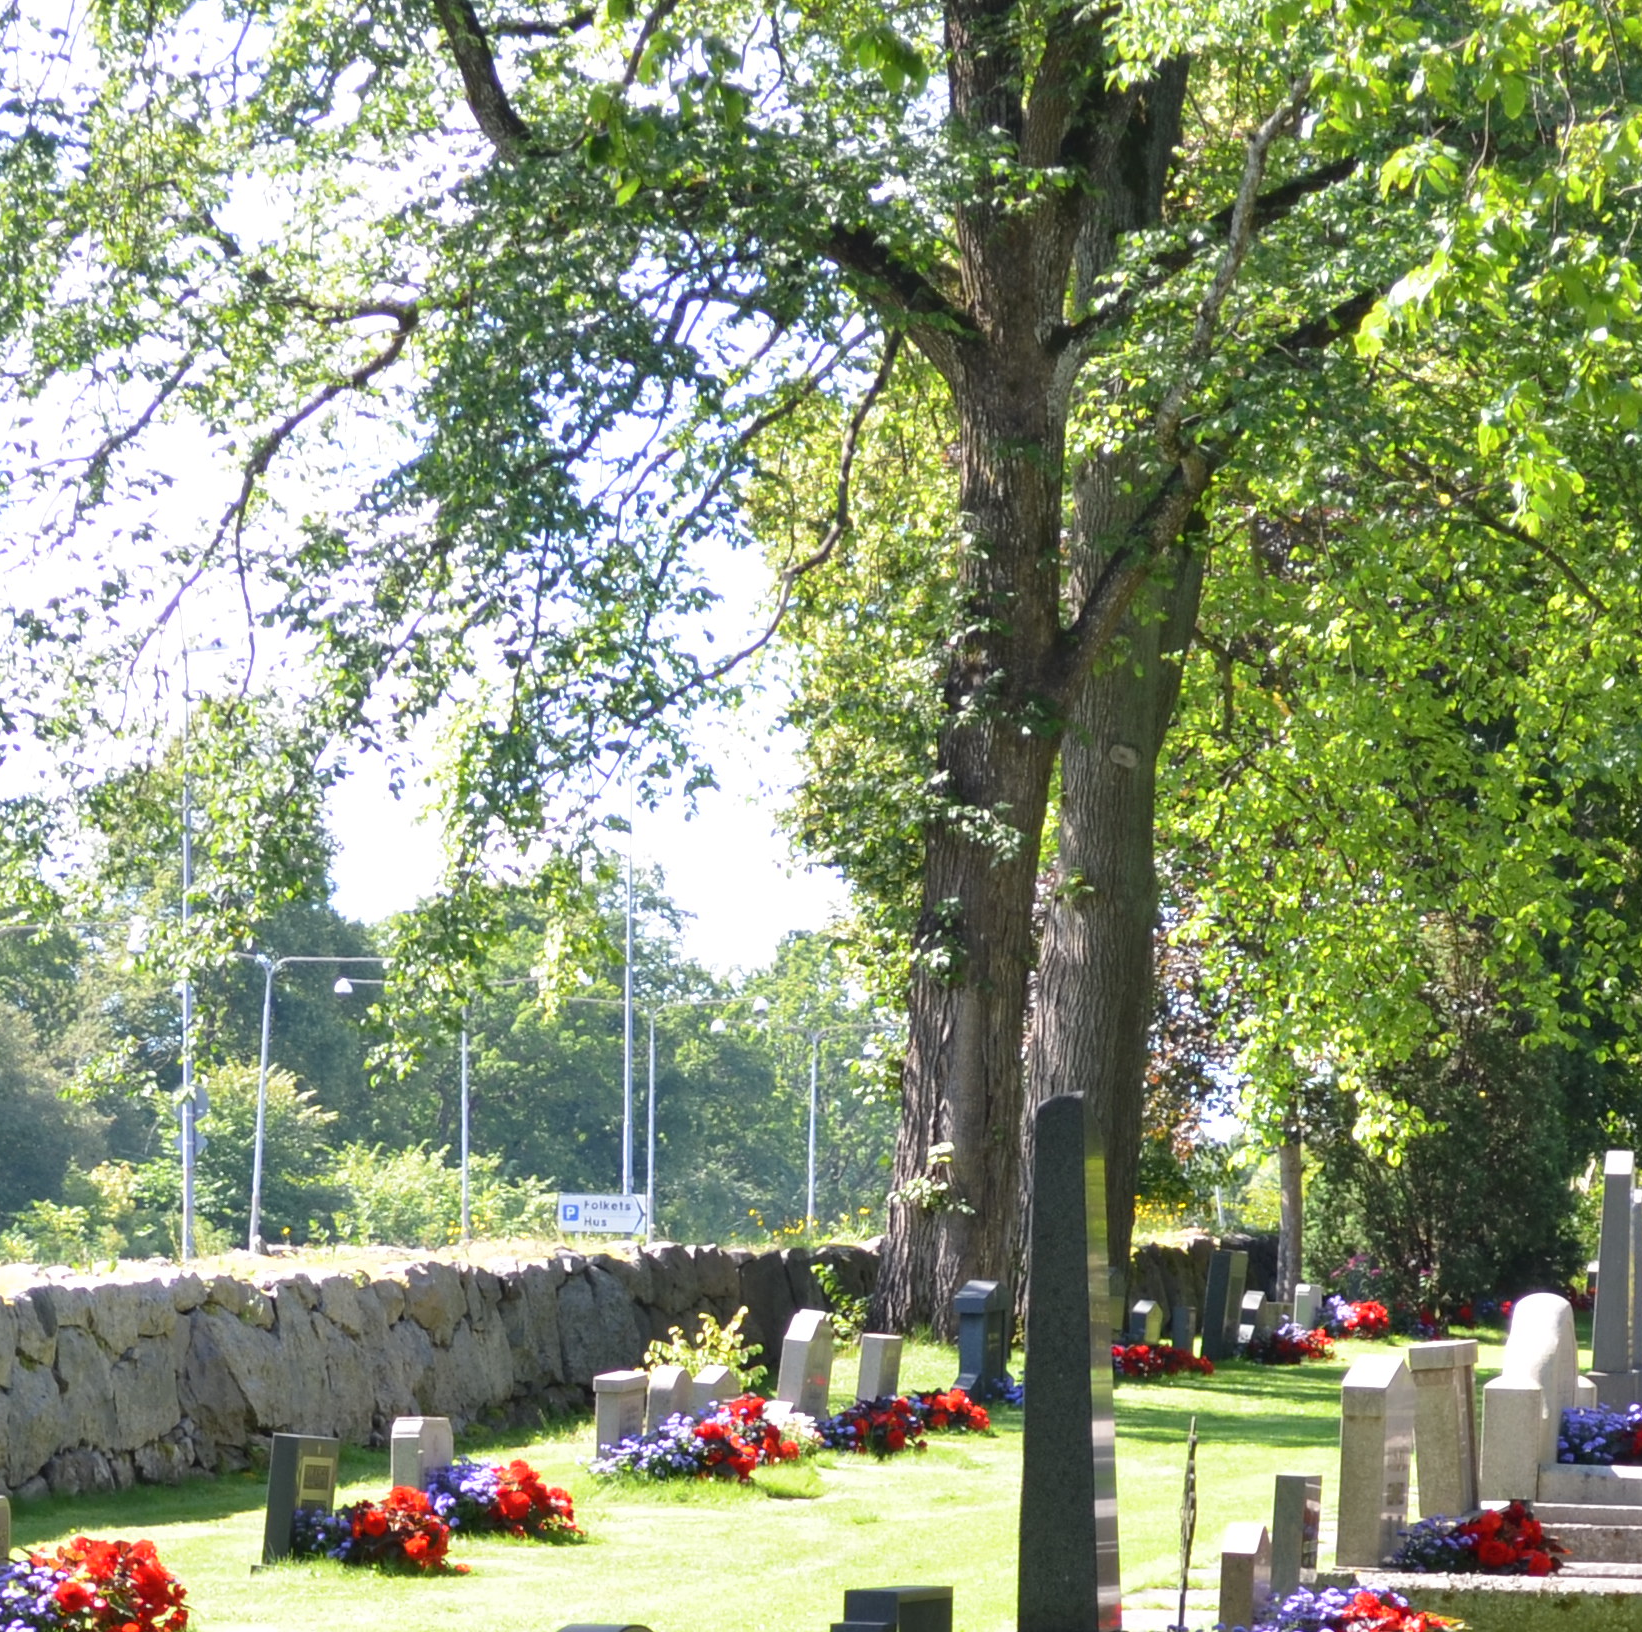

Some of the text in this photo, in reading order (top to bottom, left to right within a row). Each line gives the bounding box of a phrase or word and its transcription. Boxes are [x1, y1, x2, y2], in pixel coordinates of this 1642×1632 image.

[584, 1200, 631, 1211] Folkets
[566, 1207, 576, 1219] P
[584, 1216, 607, 1227] Hus
